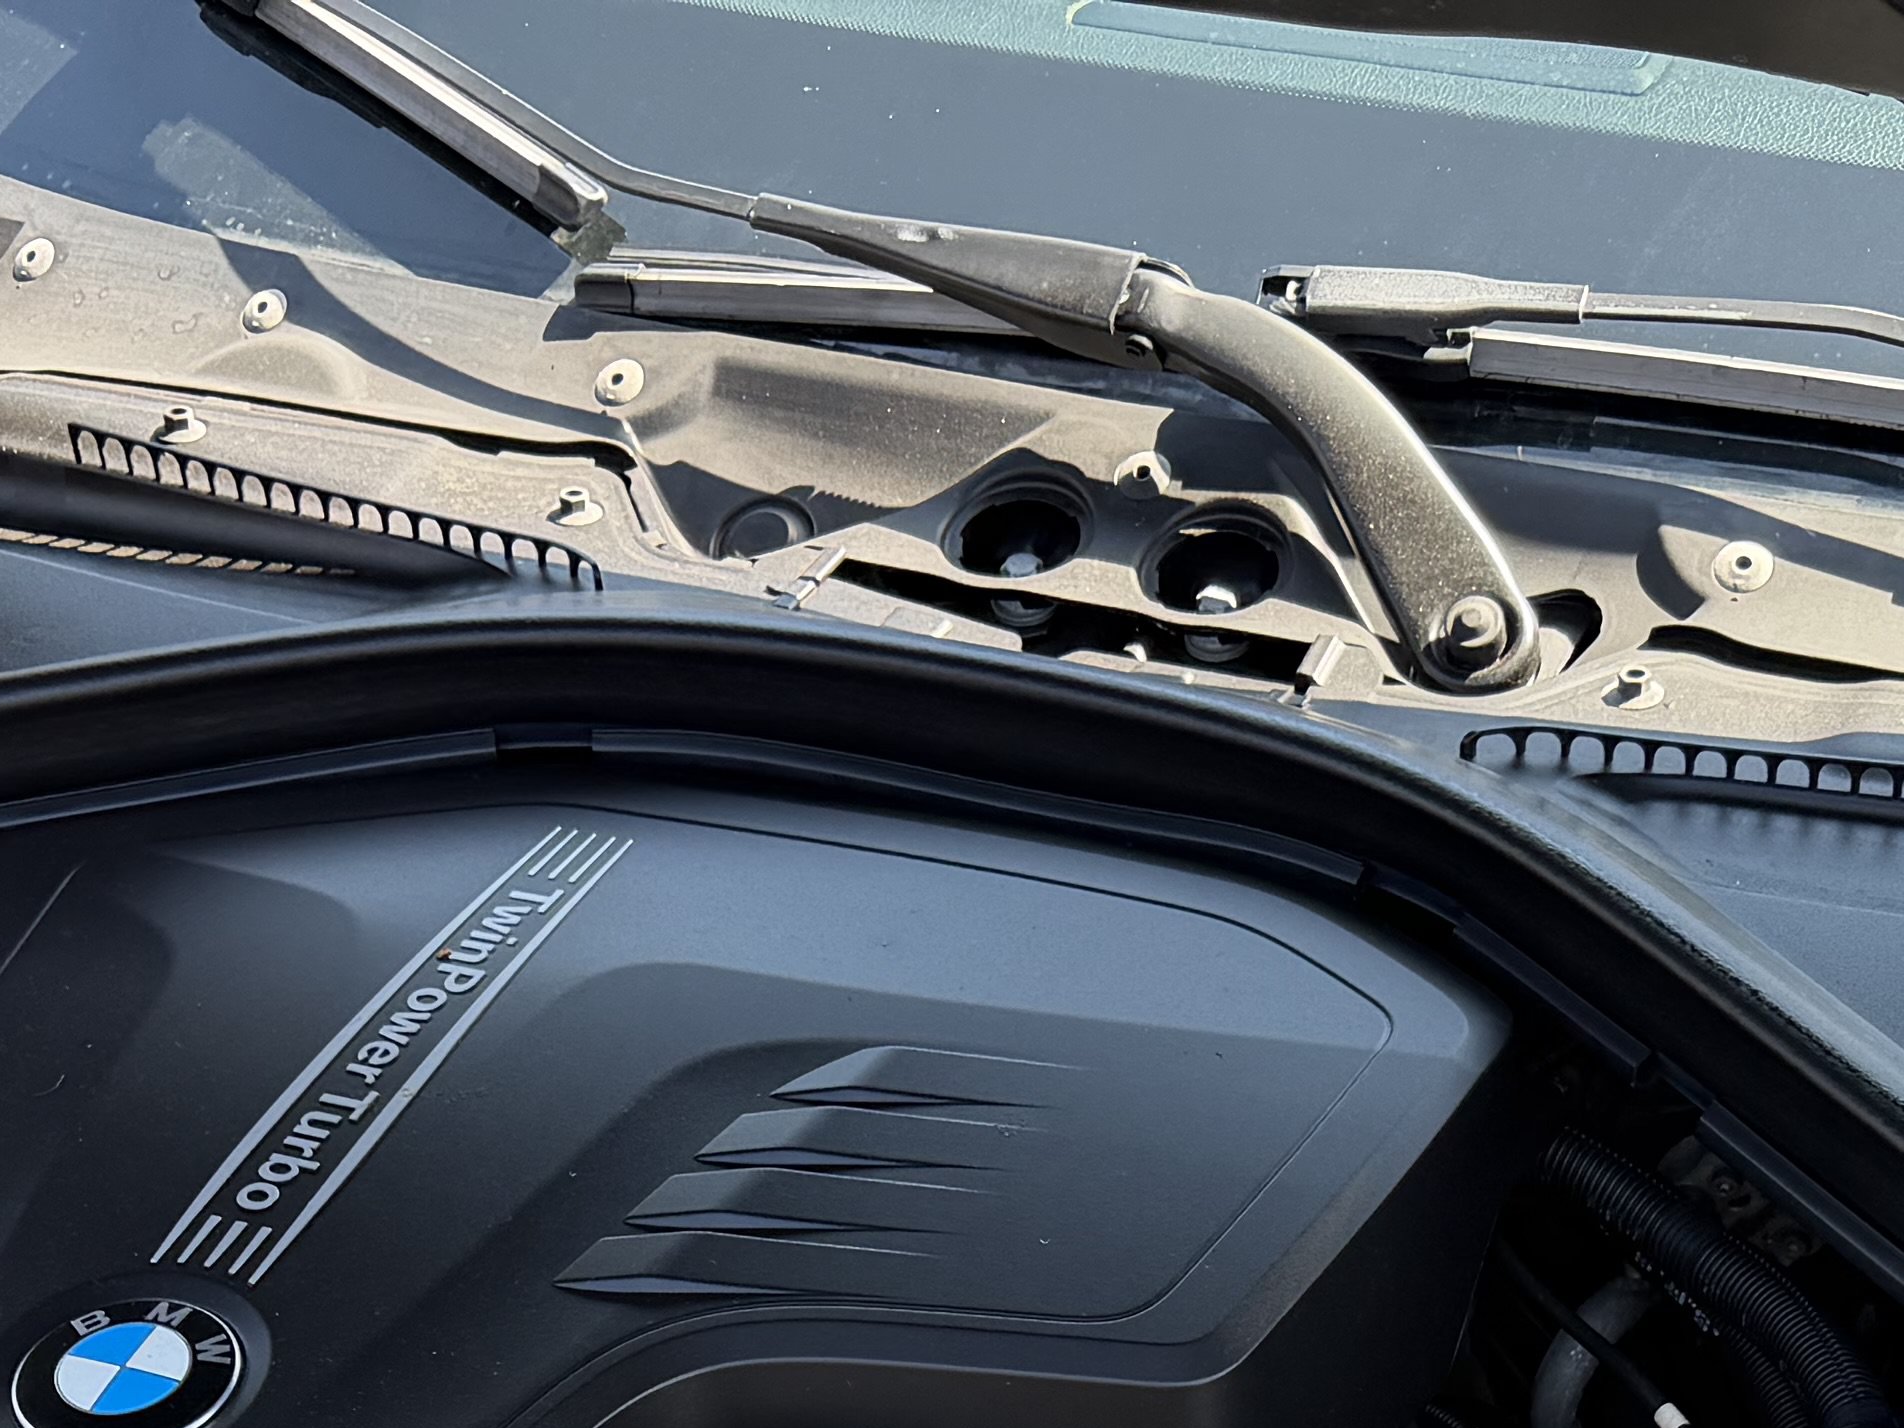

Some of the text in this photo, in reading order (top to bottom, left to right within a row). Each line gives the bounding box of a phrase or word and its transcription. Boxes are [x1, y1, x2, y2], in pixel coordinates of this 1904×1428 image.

[236, 887, 563, 1213] TwinPower Turbo
[70, 1302, 233, 1367] BMW
